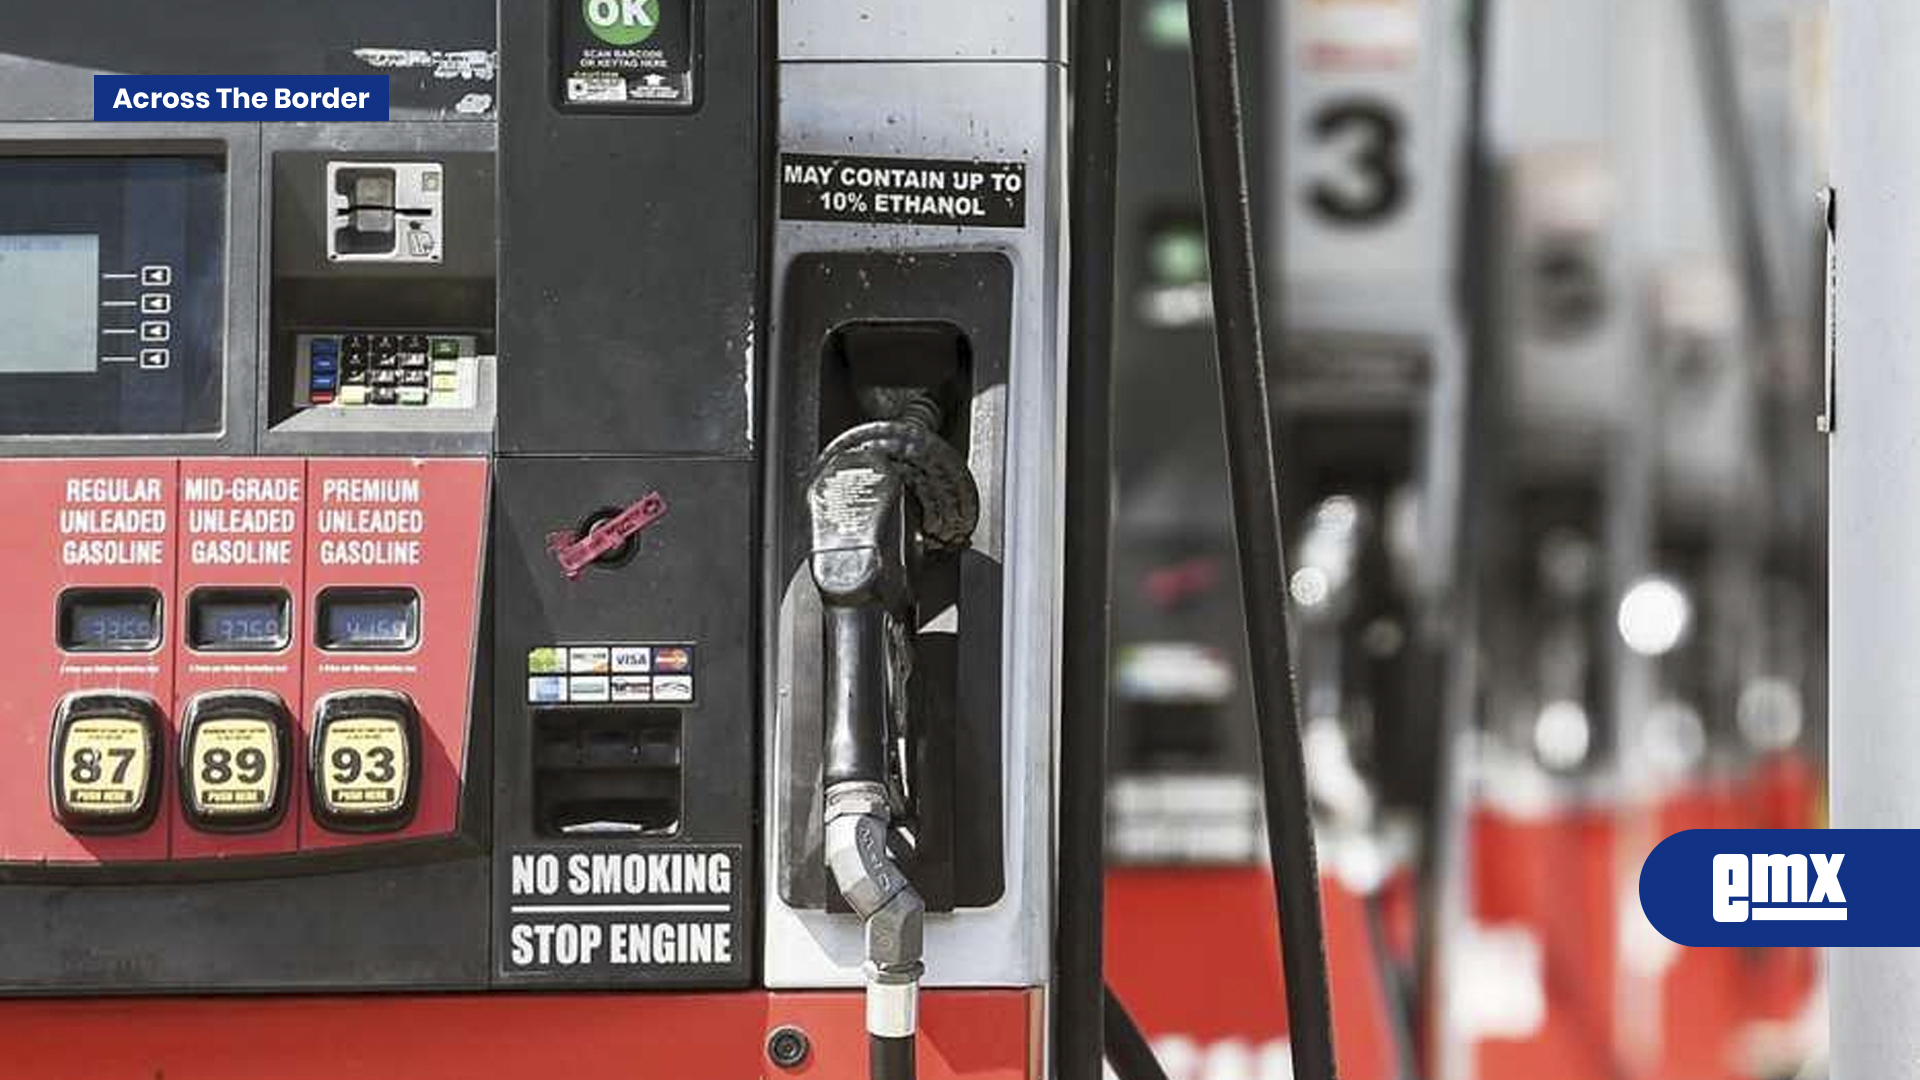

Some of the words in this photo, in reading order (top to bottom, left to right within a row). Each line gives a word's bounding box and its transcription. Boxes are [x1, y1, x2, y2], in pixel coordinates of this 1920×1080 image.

[588, 0, 656, 27] OK
[580, 60, 596, 68] OR
[597, 60, 639, 68] KEYTAG
[640, 60, 669, 68] HERE
[583, 50, 612, 58] SCAN
[613, 50, 663, 59] BARCODE
[1306, 94, 1408, 226] 3
[784, 165, 833, 184] MAY
[840, 168, 945, 190] CONTAIN
[953, 172, 984, 191] UP
[991, 174, 1022, 192] TO
[820, 192, 867, 212] 10%
[874, 194, 986, 216] ETHANOL
[66, 478, 162, 502] REGULAR
[184, 478, 300, 502] MID-GRADE
[323, 478, 420, 502] PREMIUM
[60, 509, 166, 533] UNLEADED
[189, 509, 295, 533] UNLEADED
[318, 509, 423, 533] UNLEADED
[63, 540, 164, 565] GASOLINE
[191, 540, 292, 565] GASOLINE
[320, 540, 420, 565] GASOLINE
[616, 654, 648, 666] VISA
[71, 747, 136, 784] 87
[202, 747, 266, 784] 89
[331, 747, 396, 784] 93
[512, 854, 559, 894] NO
[568, 853, 731, 894] SMOKING
[511, 923, 602, 965] STOP
[610, 923, 732, 964] ENGINE
